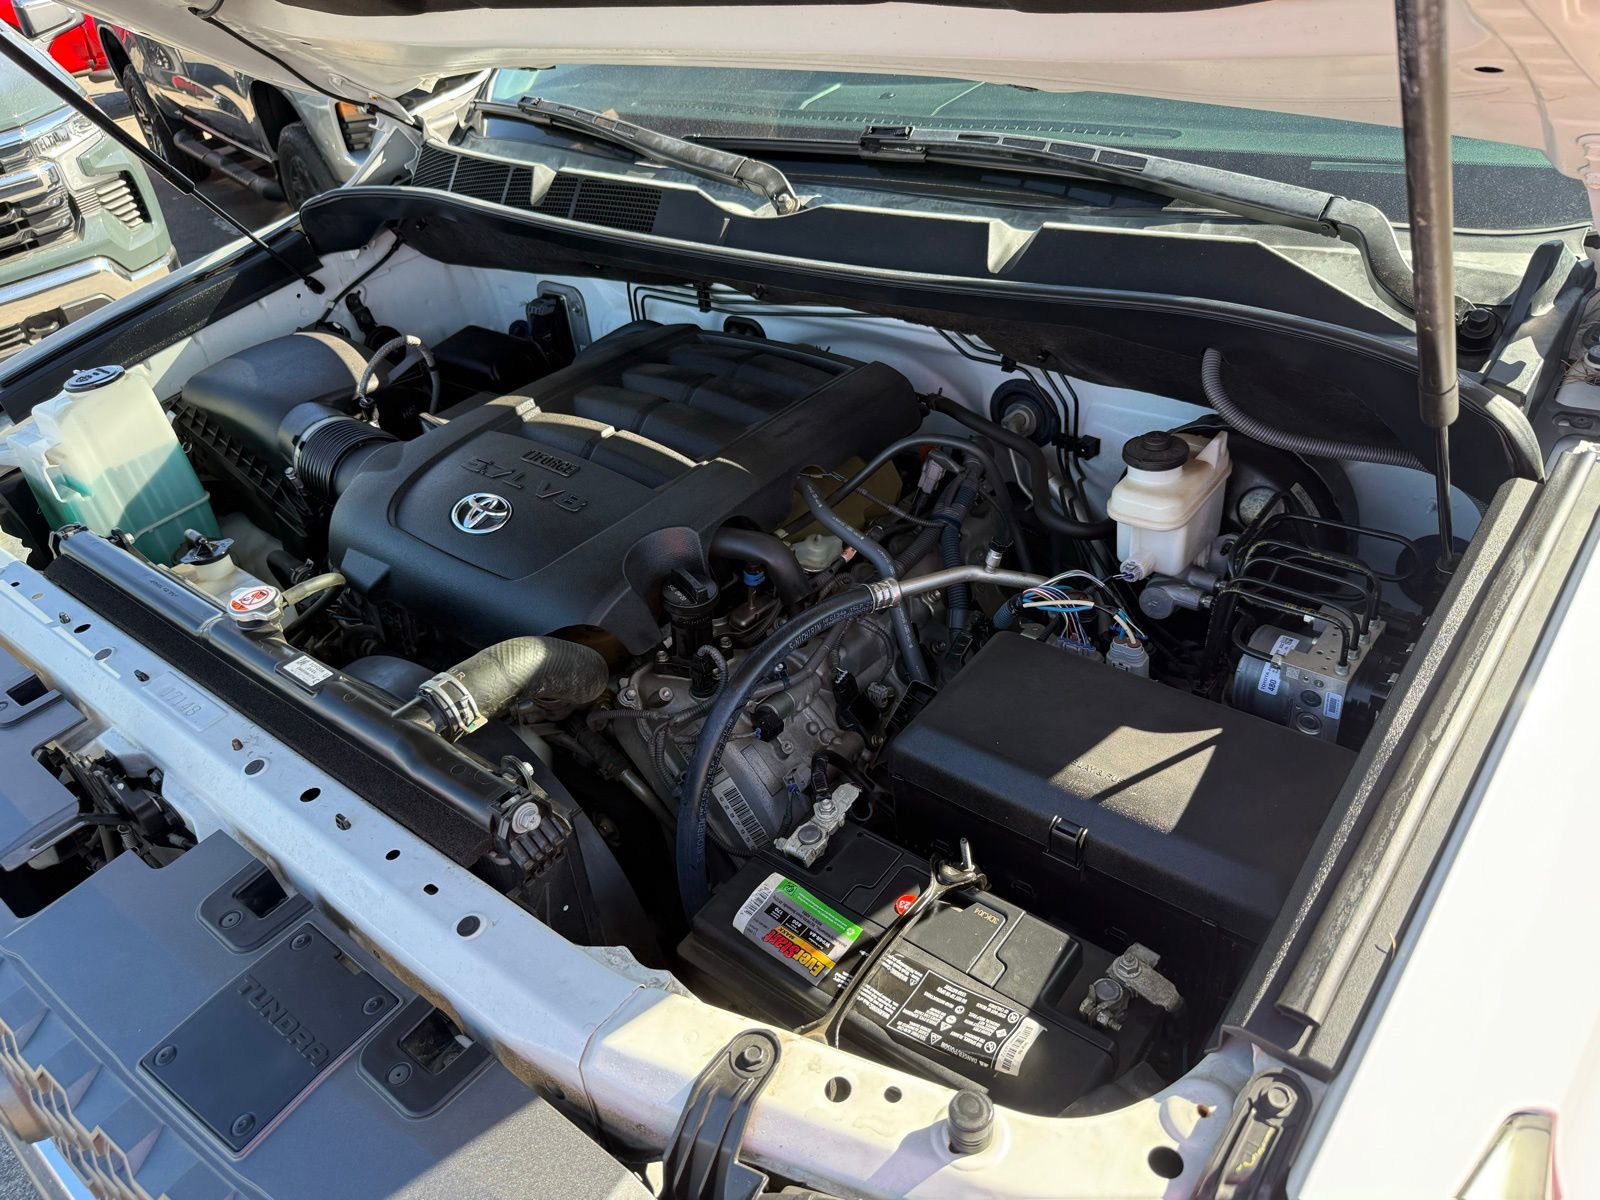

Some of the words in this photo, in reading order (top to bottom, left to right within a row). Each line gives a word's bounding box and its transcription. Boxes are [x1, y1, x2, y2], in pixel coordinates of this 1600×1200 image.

[535, 479, 588, 513] V8
[1260, 671, 1270, 690] TOYOTA
[762, 929, 824, 976] EverStart
[237, 974, 330, 1067] TUNDRA
